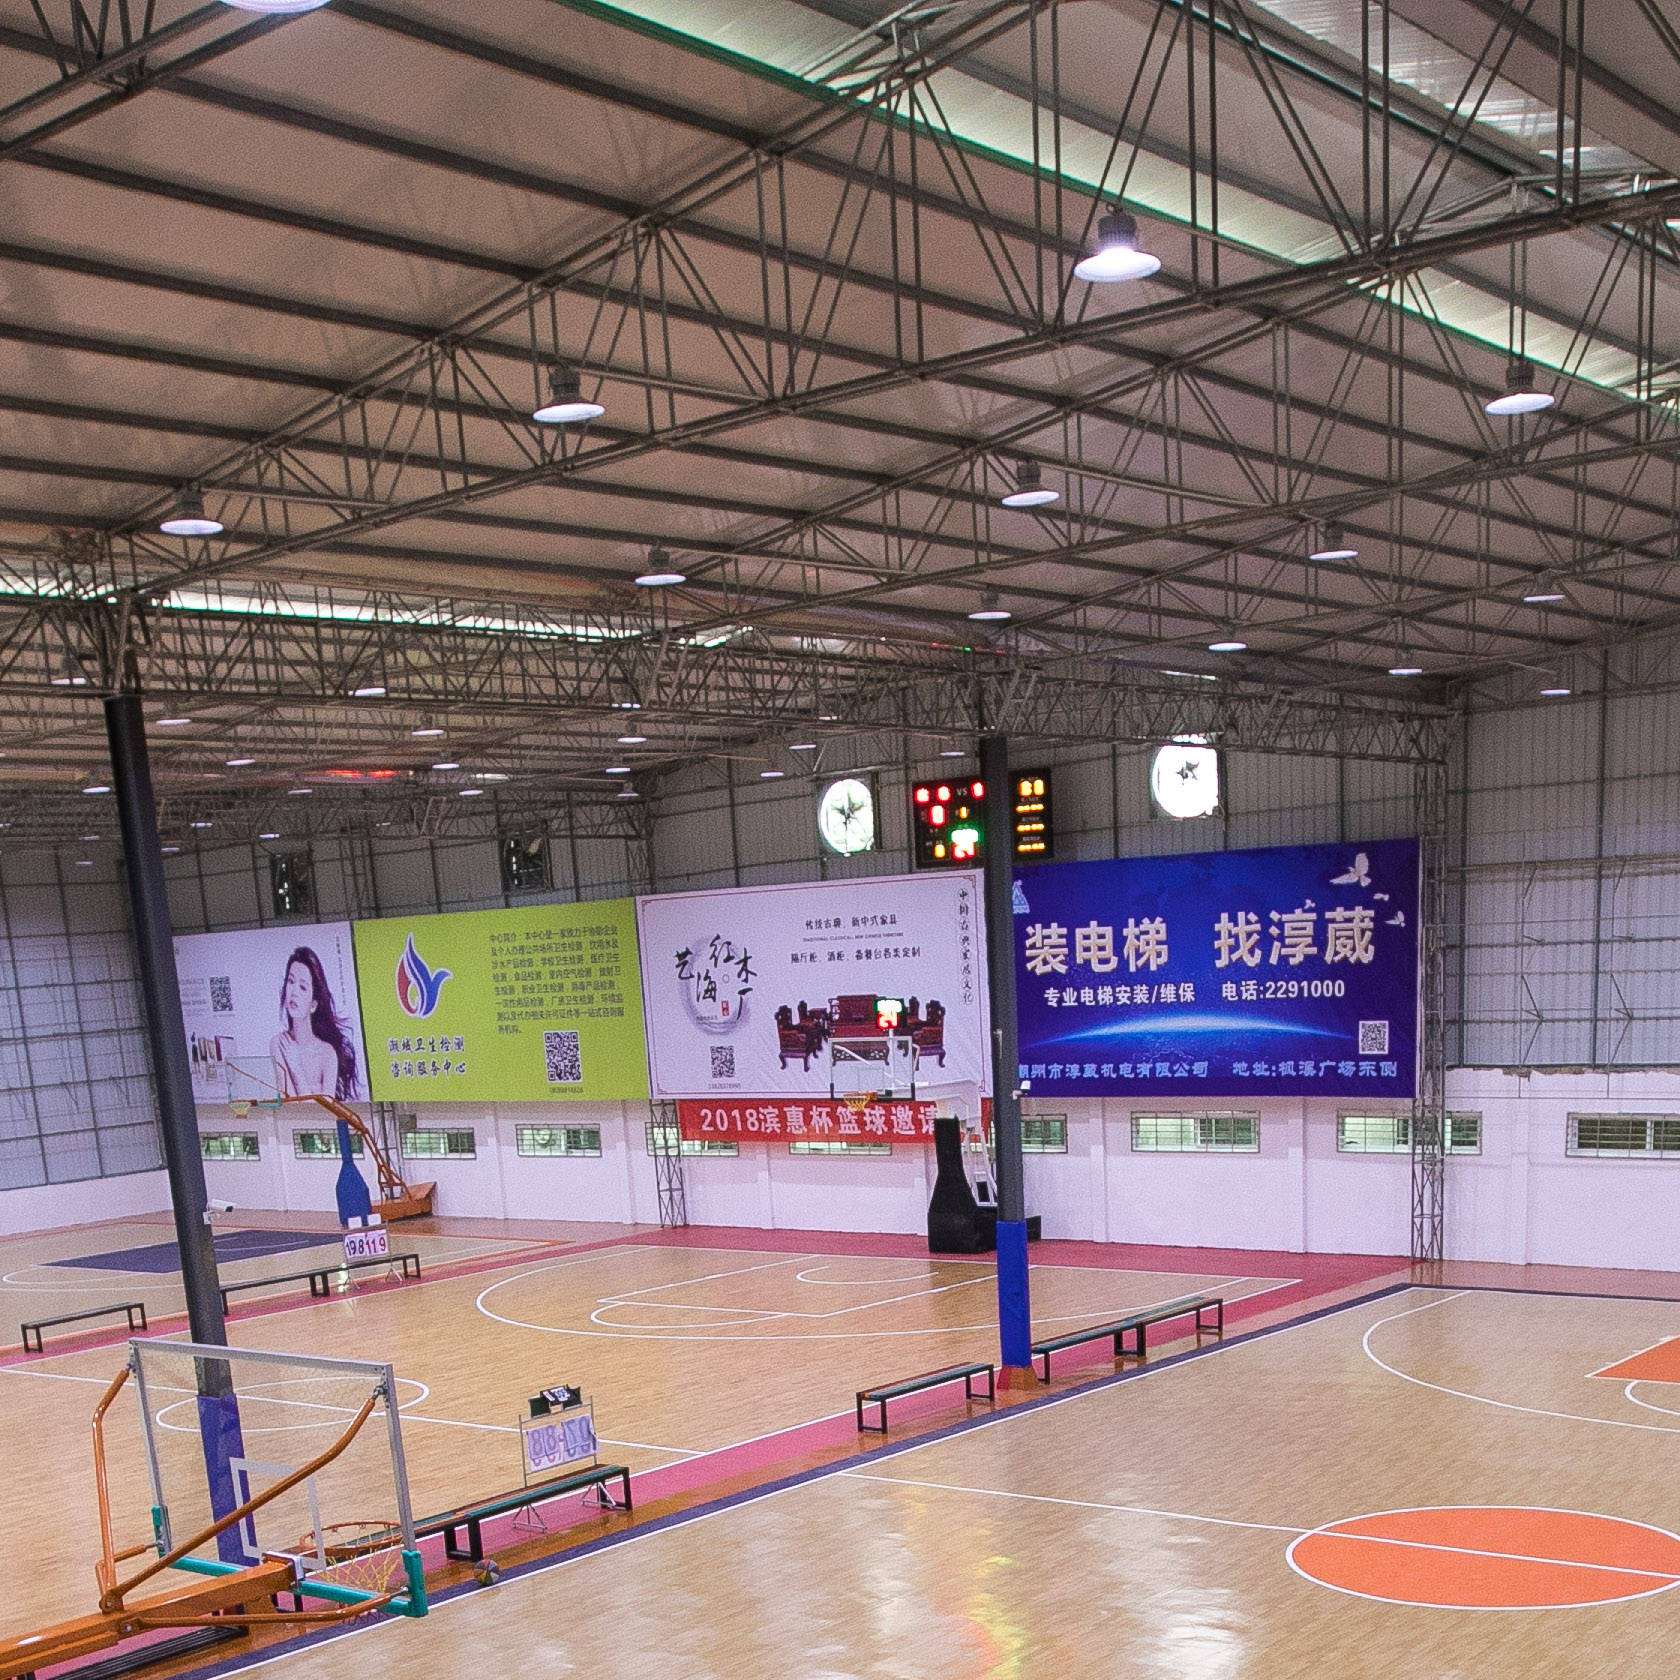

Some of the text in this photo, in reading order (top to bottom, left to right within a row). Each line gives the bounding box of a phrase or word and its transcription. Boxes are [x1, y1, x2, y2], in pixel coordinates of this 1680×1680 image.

[1024, 905, 1375, 975] 装电梯 找淳葳
[1043, 982, 1196, 1007] 专业电梯安装/维保
